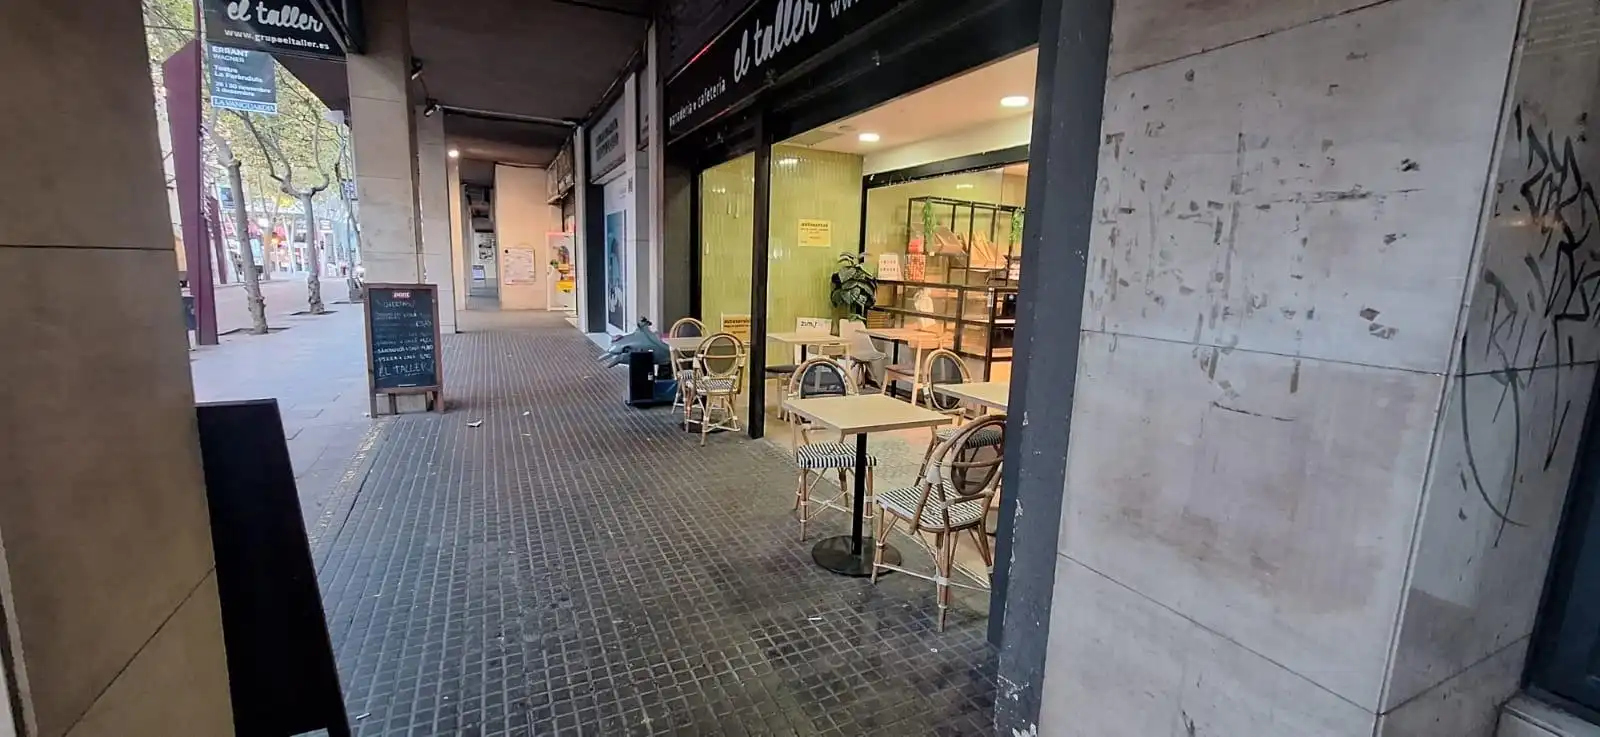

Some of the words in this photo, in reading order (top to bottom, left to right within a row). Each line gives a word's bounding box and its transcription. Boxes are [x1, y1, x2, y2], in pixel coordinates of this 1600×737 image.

[227, 0, 251, 21] el
[256, 1, 323, 32] taller
[223, 29, 331, 50] www.grupoeltaller.es
[733, 29, 751, 83] el
[754, 0, 820, 67] taller
[211, 46, 249, 57] ERRANT
[212, 53, 245, 63] WAGNER
[225, 99, 275, 111] VANGUARDIA
